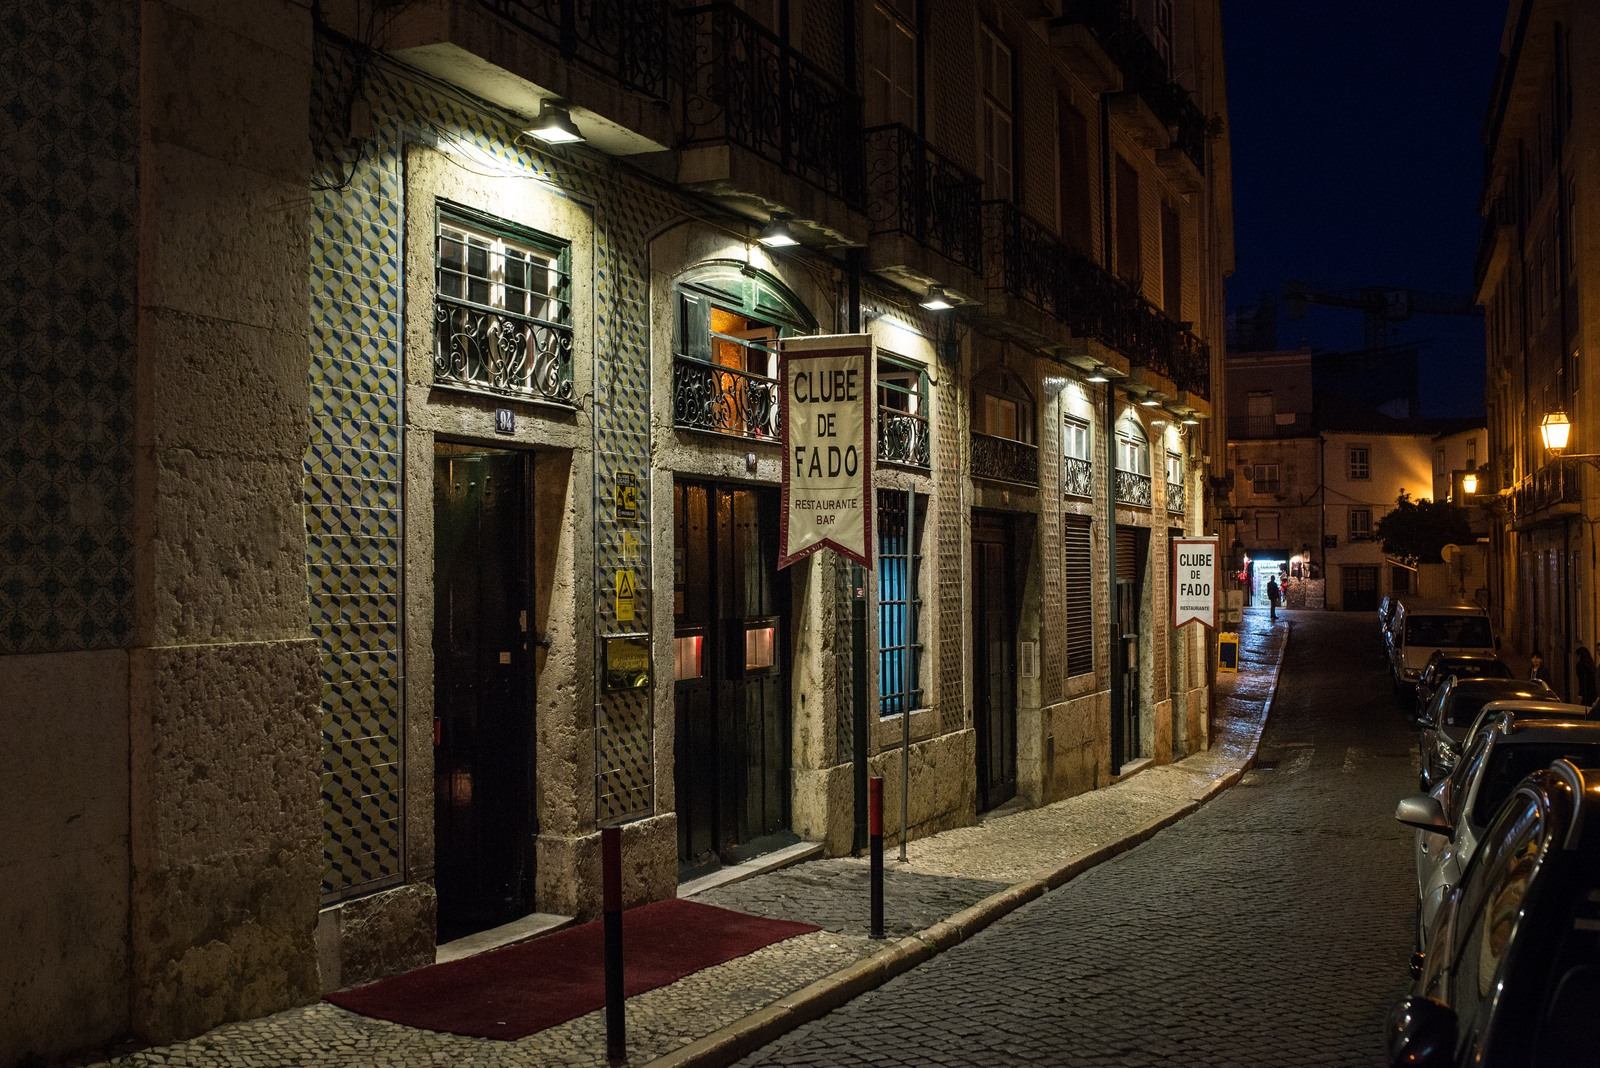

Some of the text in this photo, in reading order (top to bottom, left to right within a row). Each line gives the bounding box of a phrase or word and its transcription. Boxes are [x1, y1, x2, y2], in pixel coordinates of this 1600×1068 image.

[794, 370, 858, 403] CLUBE
[817, 413, 836, 438] DE
[795, 445, 858, 478] FADO
[795, 499, 857, 510] RESTAURANTE
[816, 514, 836, 525] BAR
[1180, 554, 1212, 567] CLUBE
[1190, 570, 1200, 579] DE
[1180, 583, 1210, 596] FADO
